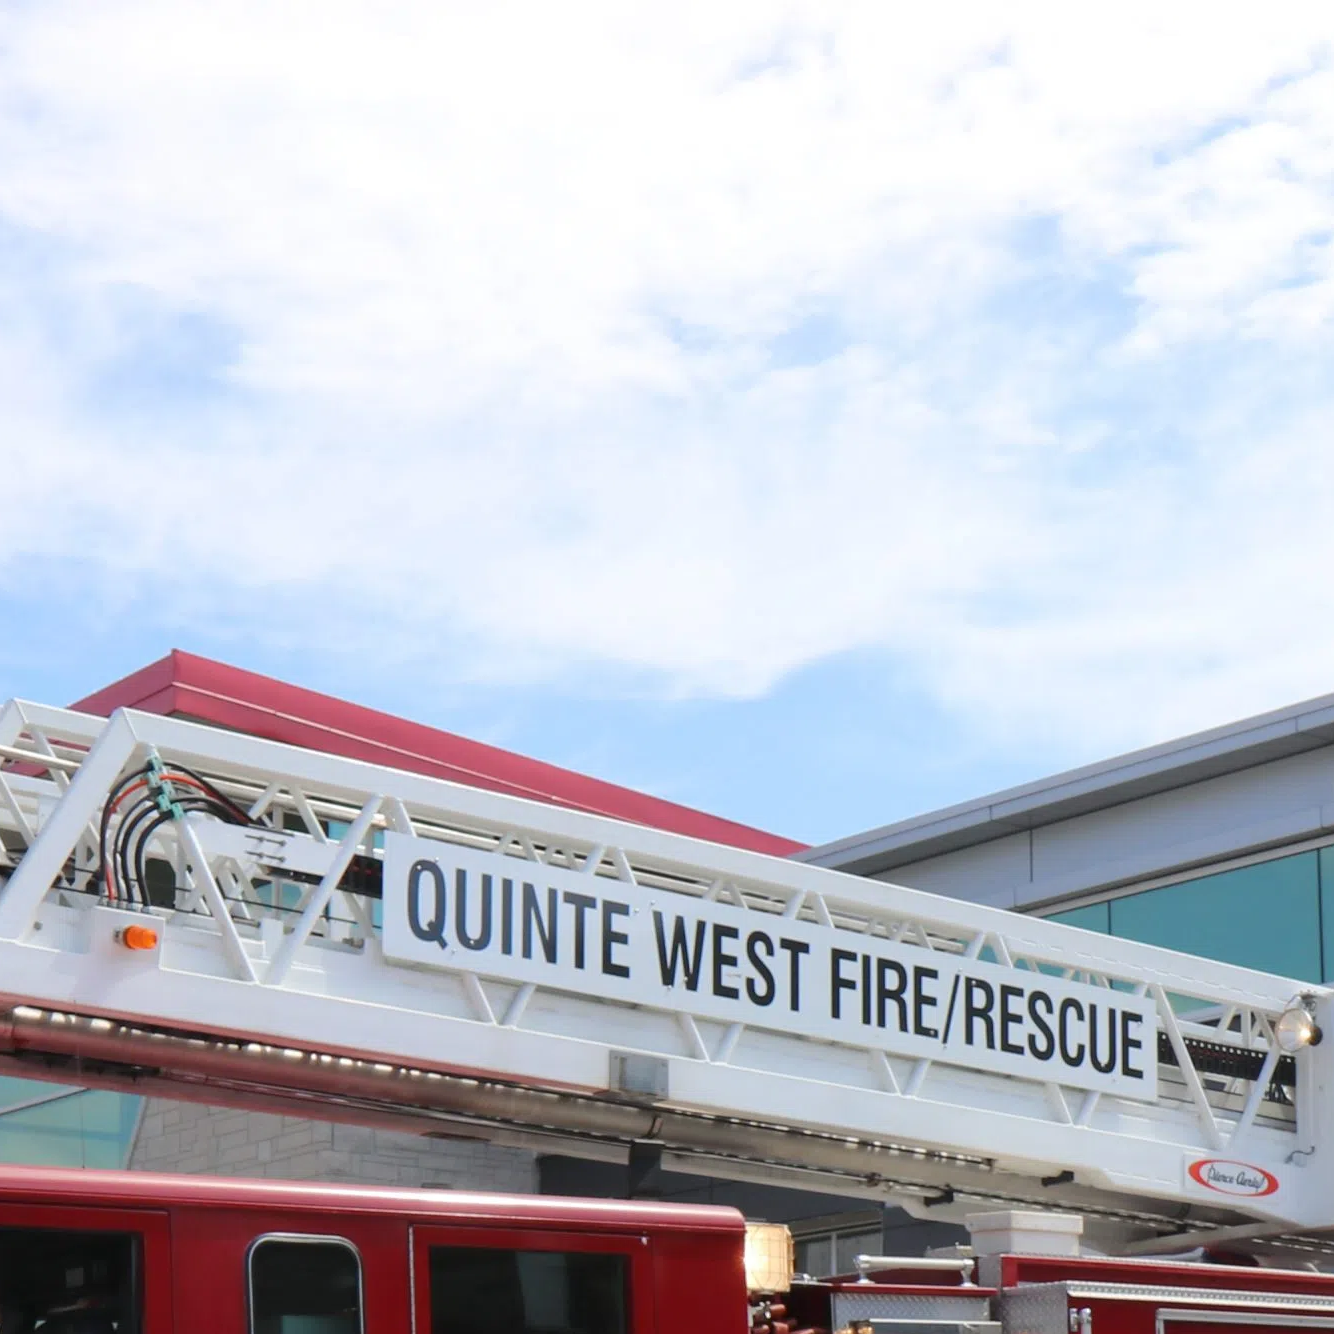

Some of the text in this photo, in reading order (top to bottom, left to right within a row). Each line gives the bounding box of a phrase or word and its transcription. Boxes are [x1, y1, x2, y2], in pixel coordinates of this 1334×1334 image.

[407, 859, 1144, 1080] QUINTE WEST FIRE/RESCUE
